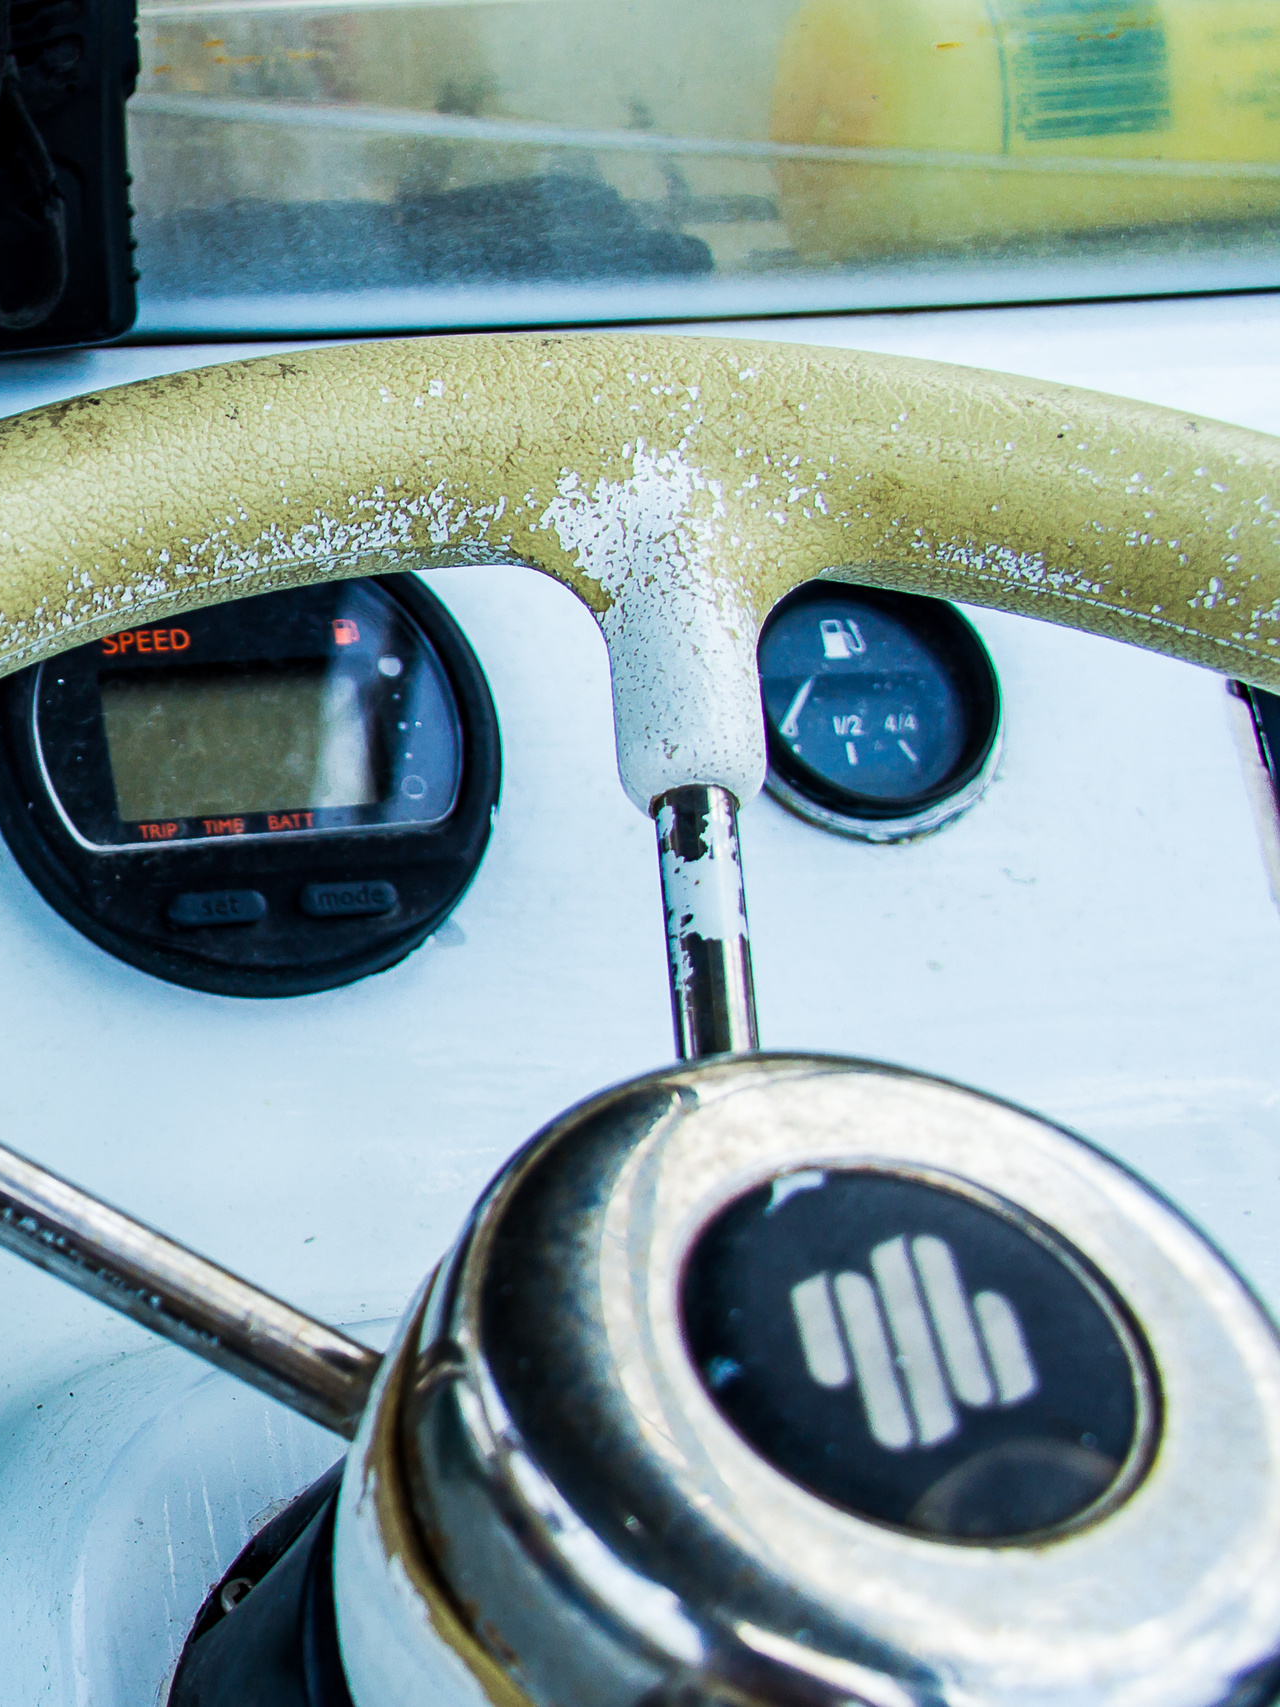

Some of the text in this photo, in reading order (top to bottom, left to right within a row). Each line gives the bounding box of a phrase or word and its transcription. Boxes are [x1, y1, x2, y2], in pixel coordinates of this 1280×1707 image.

[102, 629, 191, 655] SPEED
[832, 714, 864, 736] 1/2
[884, 712, 919, 733] 4/4
[139, 812, 314, 841] TRIP TIME BATT
[201, 885, 386, 916] set mode
